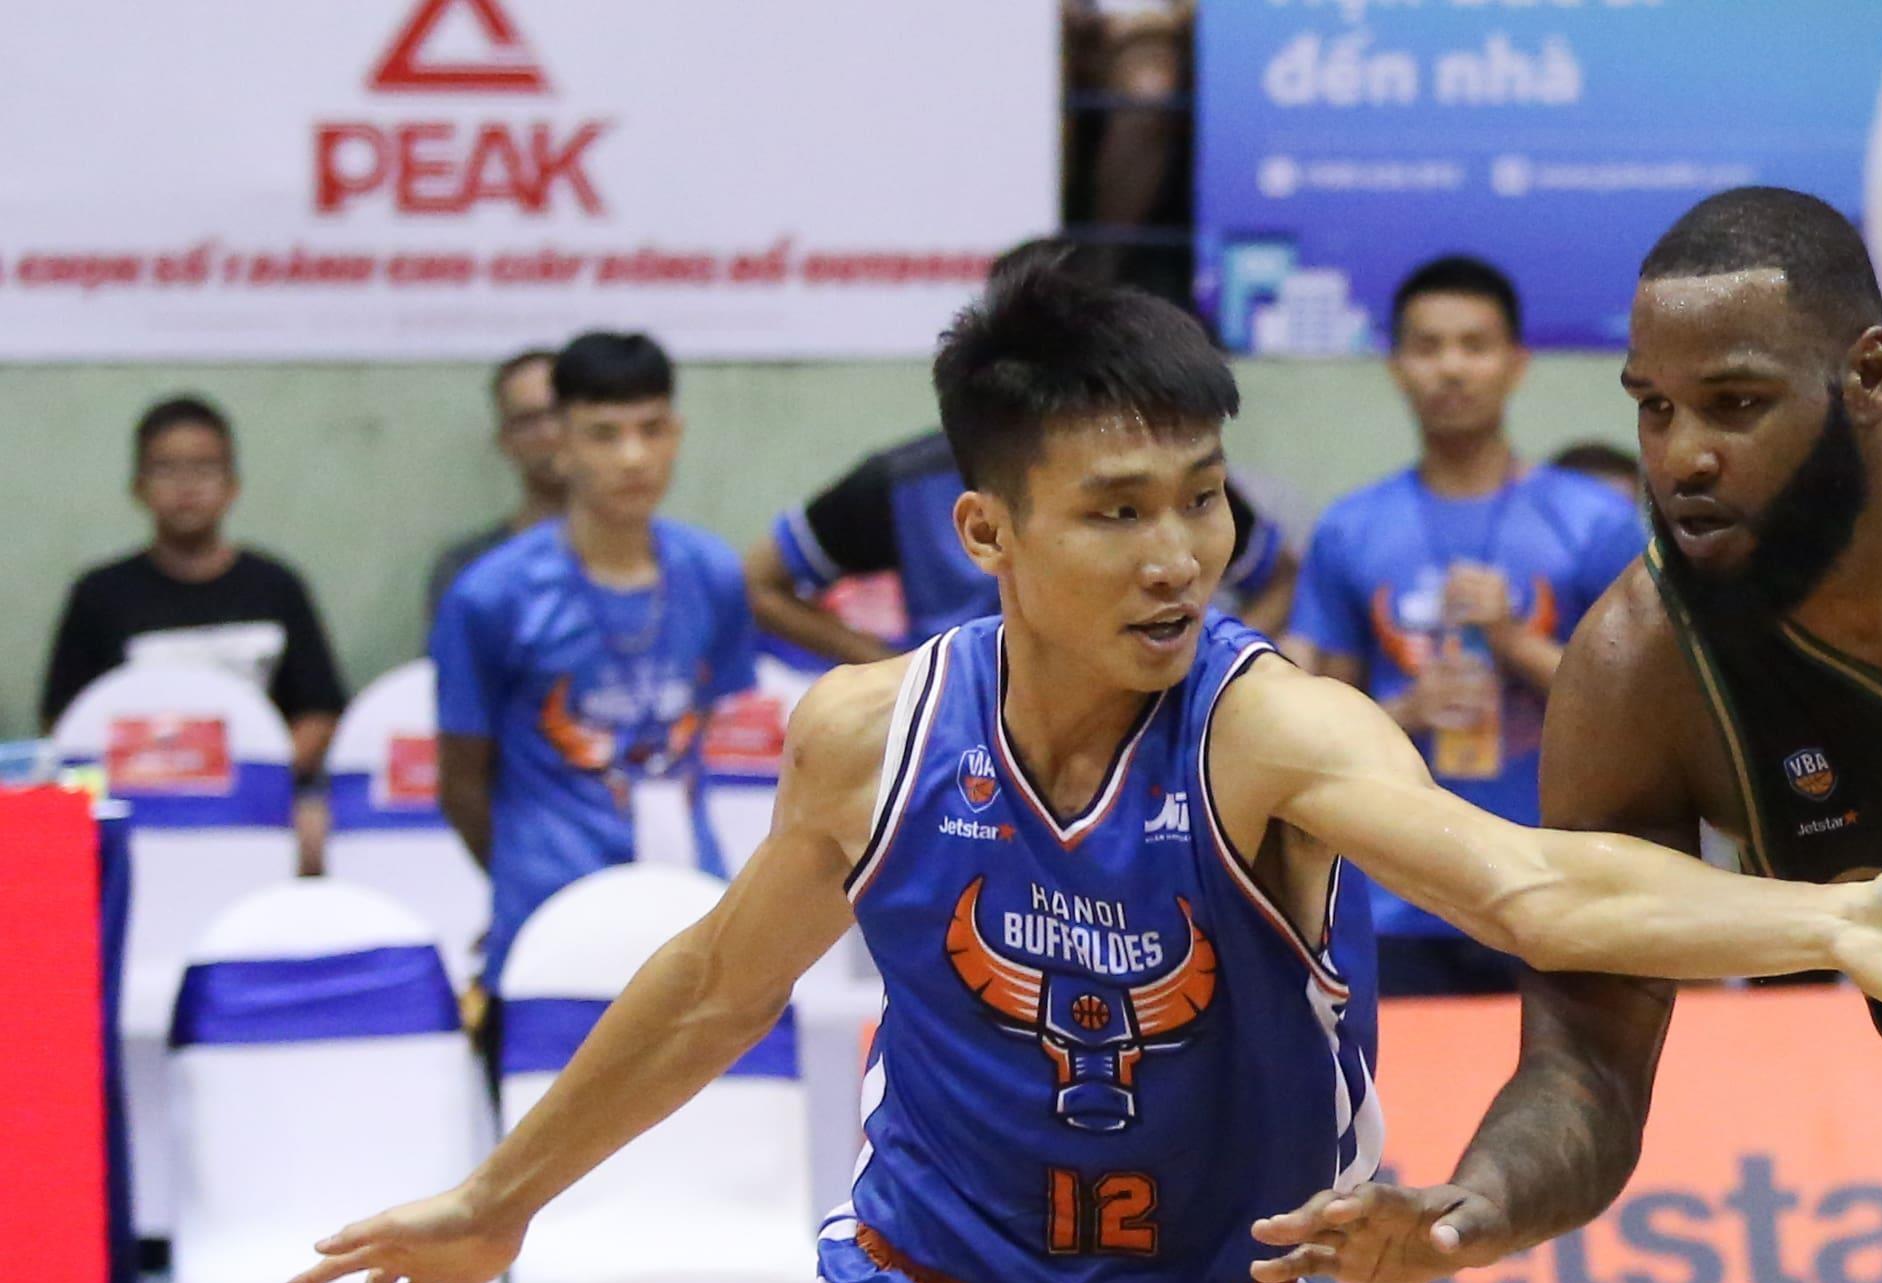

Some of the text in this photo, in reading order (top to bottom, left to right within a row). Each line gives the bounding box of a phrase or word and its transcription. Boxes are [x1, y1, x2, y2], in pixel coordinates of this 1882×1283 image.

[1435, 34, 1582, 104] nhà
[311, 118, 612, 218] PEAK
[1789, 752, 1829, 777] VBA
[939, 815, 999, 840] Jetstar
[1798, 816, 1844, 836] Jetstar
[1031, 882, 1126, 930] HANOI
[1004, 911, 1164, 976] BUFFALOES
[1048, 1168, 1157, 1256] 12
